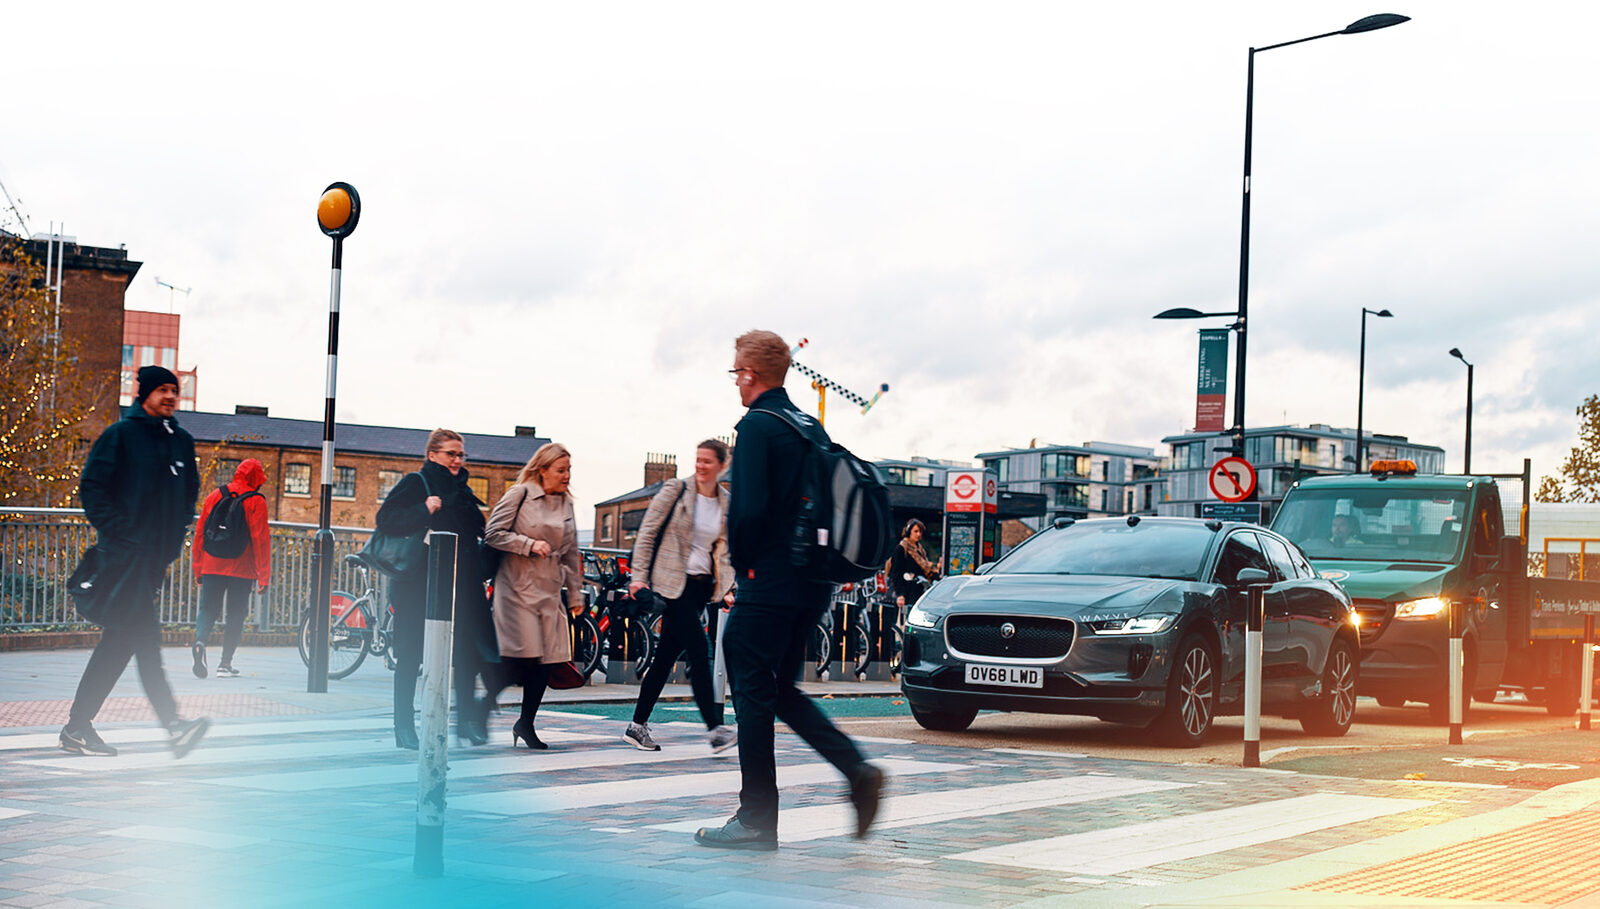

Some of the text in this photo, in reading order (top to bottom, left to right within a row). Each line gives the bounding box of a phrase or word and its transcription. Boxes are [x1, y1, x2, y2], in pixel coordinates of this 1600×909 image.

[1078, 612, 1130, 622] WAYVE
[971, 667, 1038, 684] OV68 LWD
